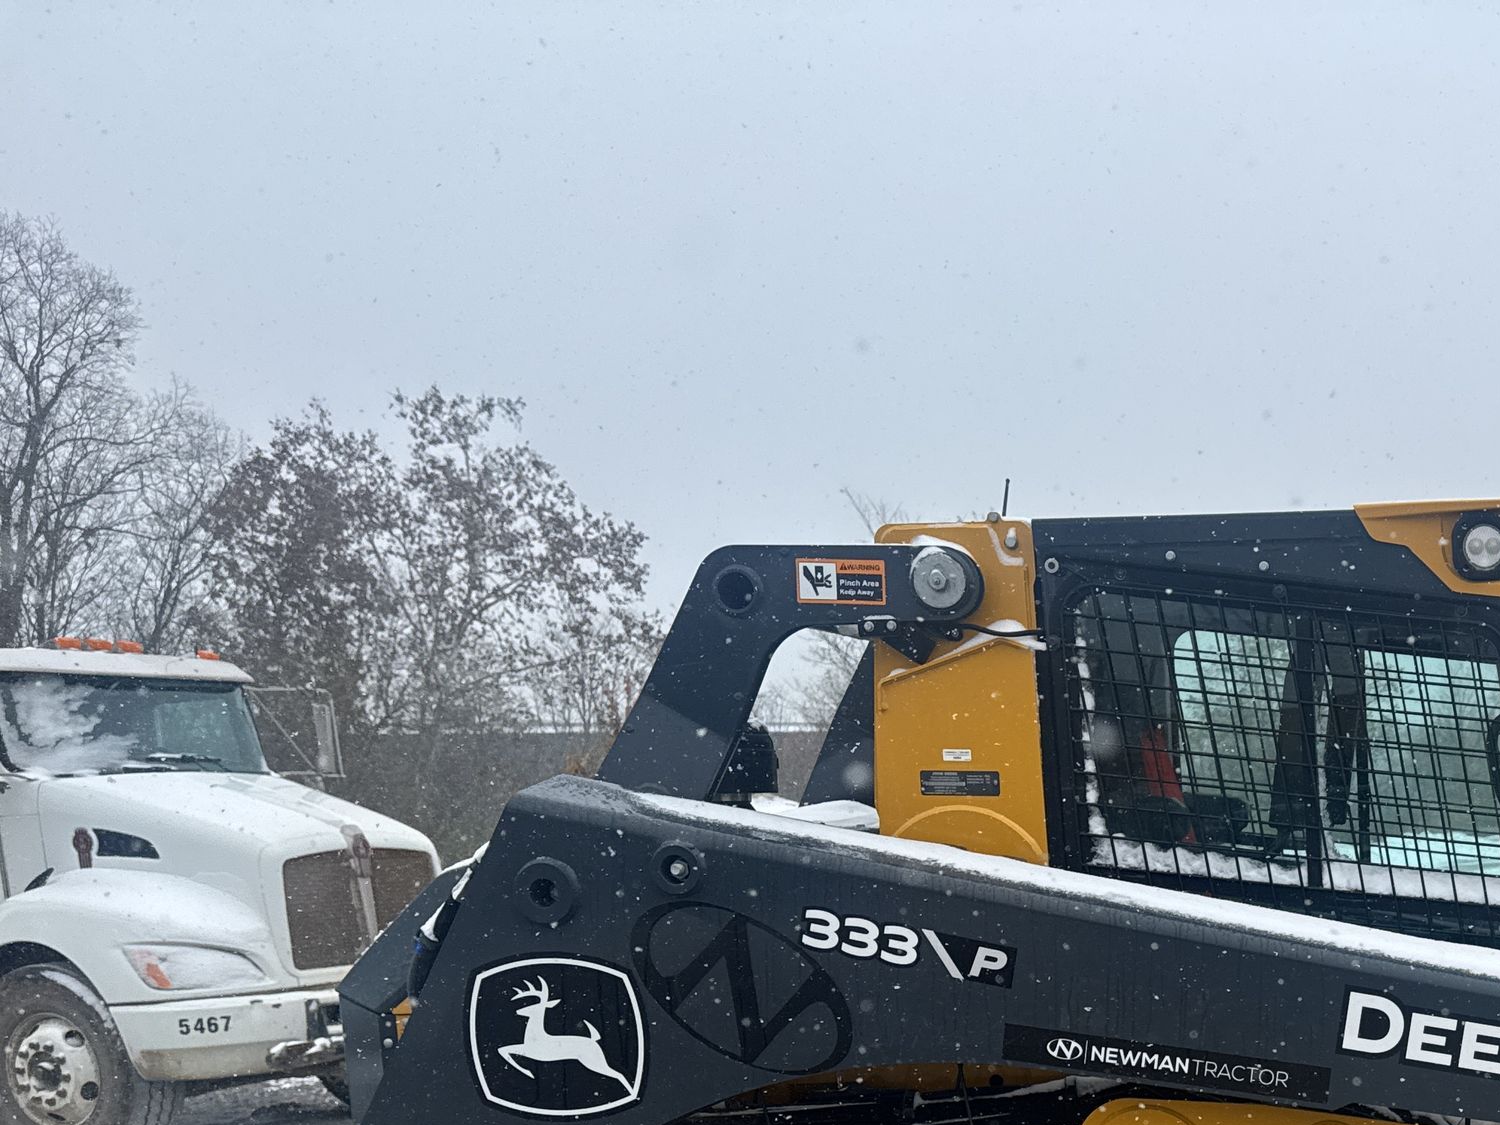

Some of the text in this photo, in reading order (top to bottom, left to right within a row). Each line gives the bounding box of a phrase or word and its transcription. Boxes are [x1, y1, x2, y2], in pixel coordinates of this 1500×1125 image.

[847, 563, 880, 571] WARNING
[839, 579, 861, 587] Pinch
[857, 589, 874, 597] Away
[178, 1015, 232, 1036] 5467
